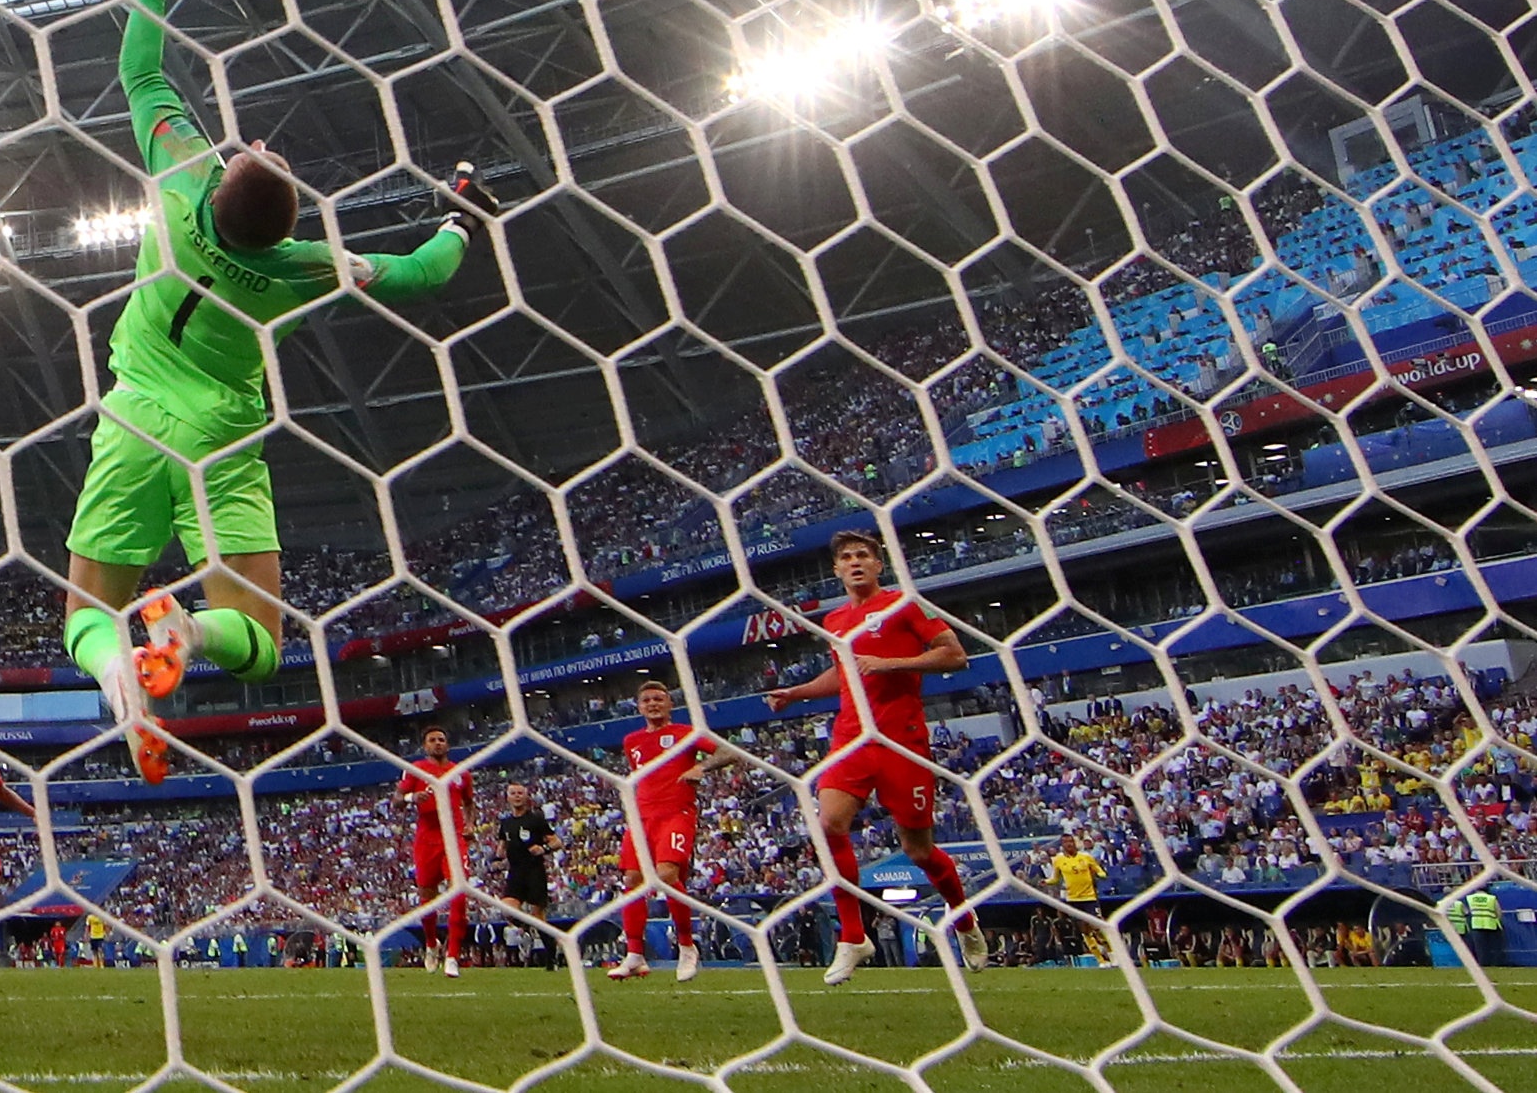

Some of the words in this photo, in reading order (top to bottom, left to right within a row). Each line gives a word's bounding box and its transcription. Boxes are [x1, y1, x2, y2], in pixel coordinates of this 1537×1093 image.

[168, 275, 215, 348] 1
[1383, 352, 1481, 389] worldcup
[248, 714, 298, 727] #worldcup
[913, 786, 927, 811] 5
[670, 832, 686, 853] 12
[873, 871, 912, 883] SAMARA
